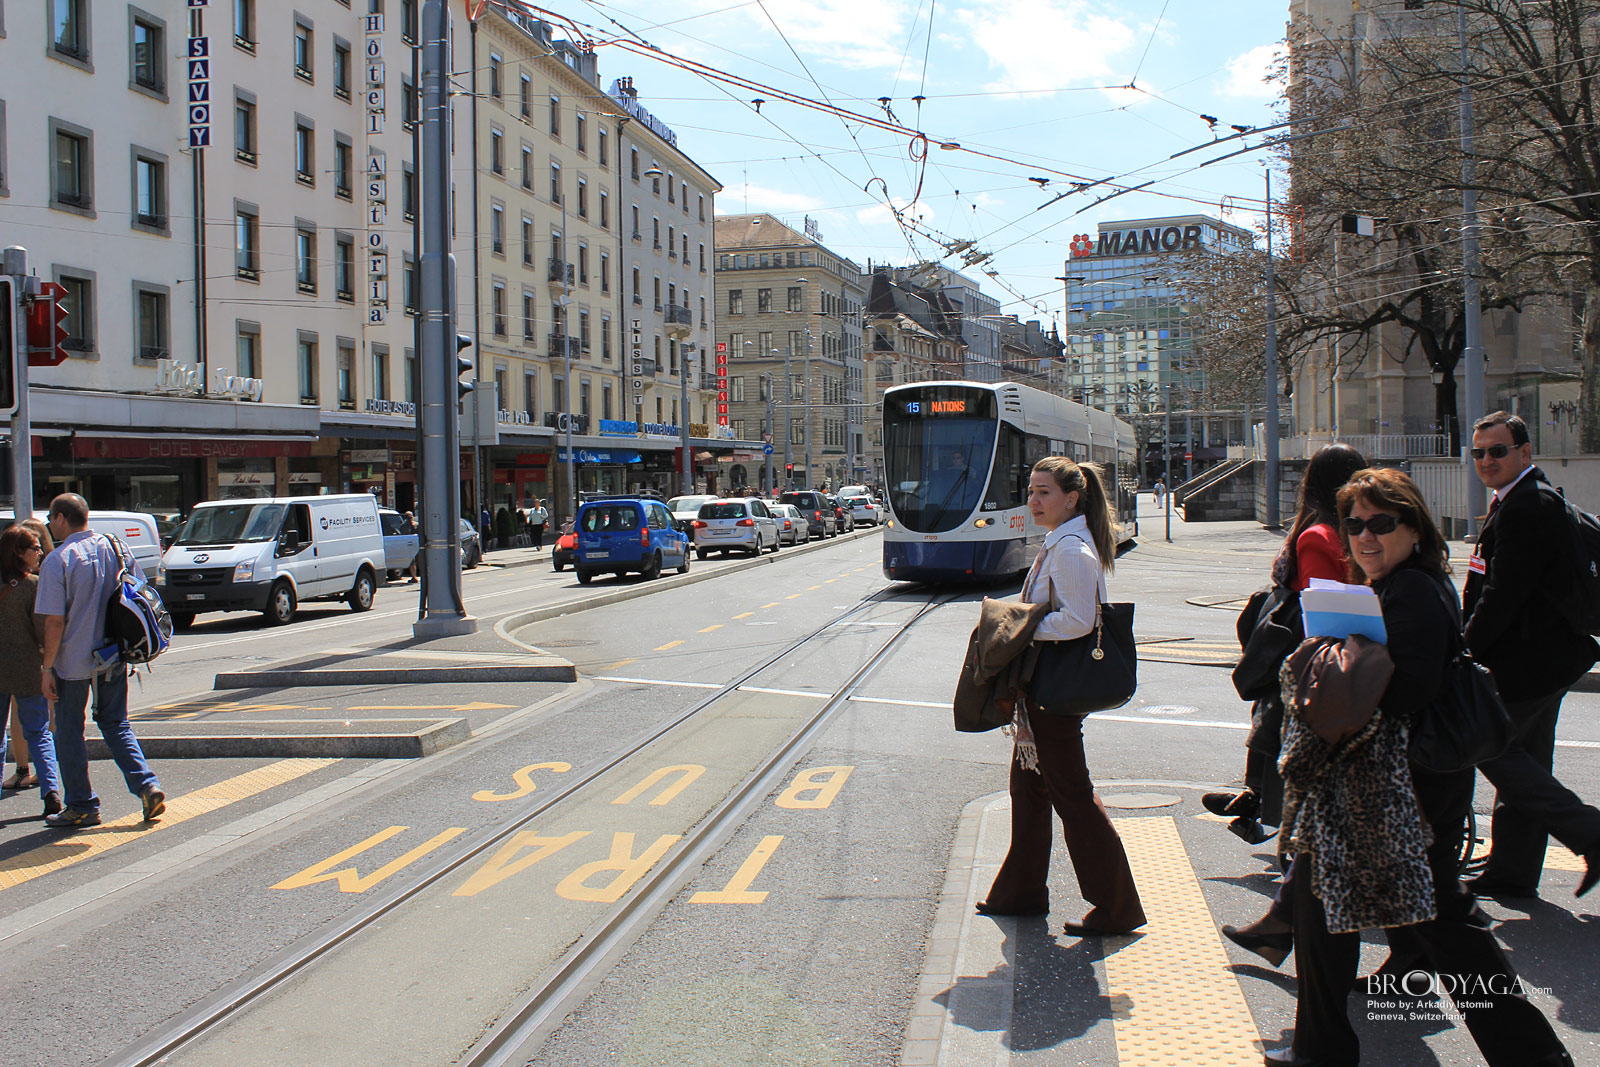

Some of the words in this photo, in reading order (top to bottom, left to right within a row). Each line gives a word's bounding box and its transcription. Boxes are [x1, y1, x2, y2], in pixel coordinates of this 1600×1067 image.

[190, 38, 208, 146] SAVOY
[366, 15, 381, 133] Hôtel
[368, 157, 384, 323] Astoria
[1096, 224, 1203, 256] MANOR
[632, 319, 643, 404] TISSOT
[906, 401, 920, 413] 15
[931, 400, 966, 413] NATIONS
[201, 442, 247, 457] SAVOY
[352, 515, 376, 524] SERVICES
[471, 761, 856, 810] BUS
[268, 825, 786, 905] TRAM
